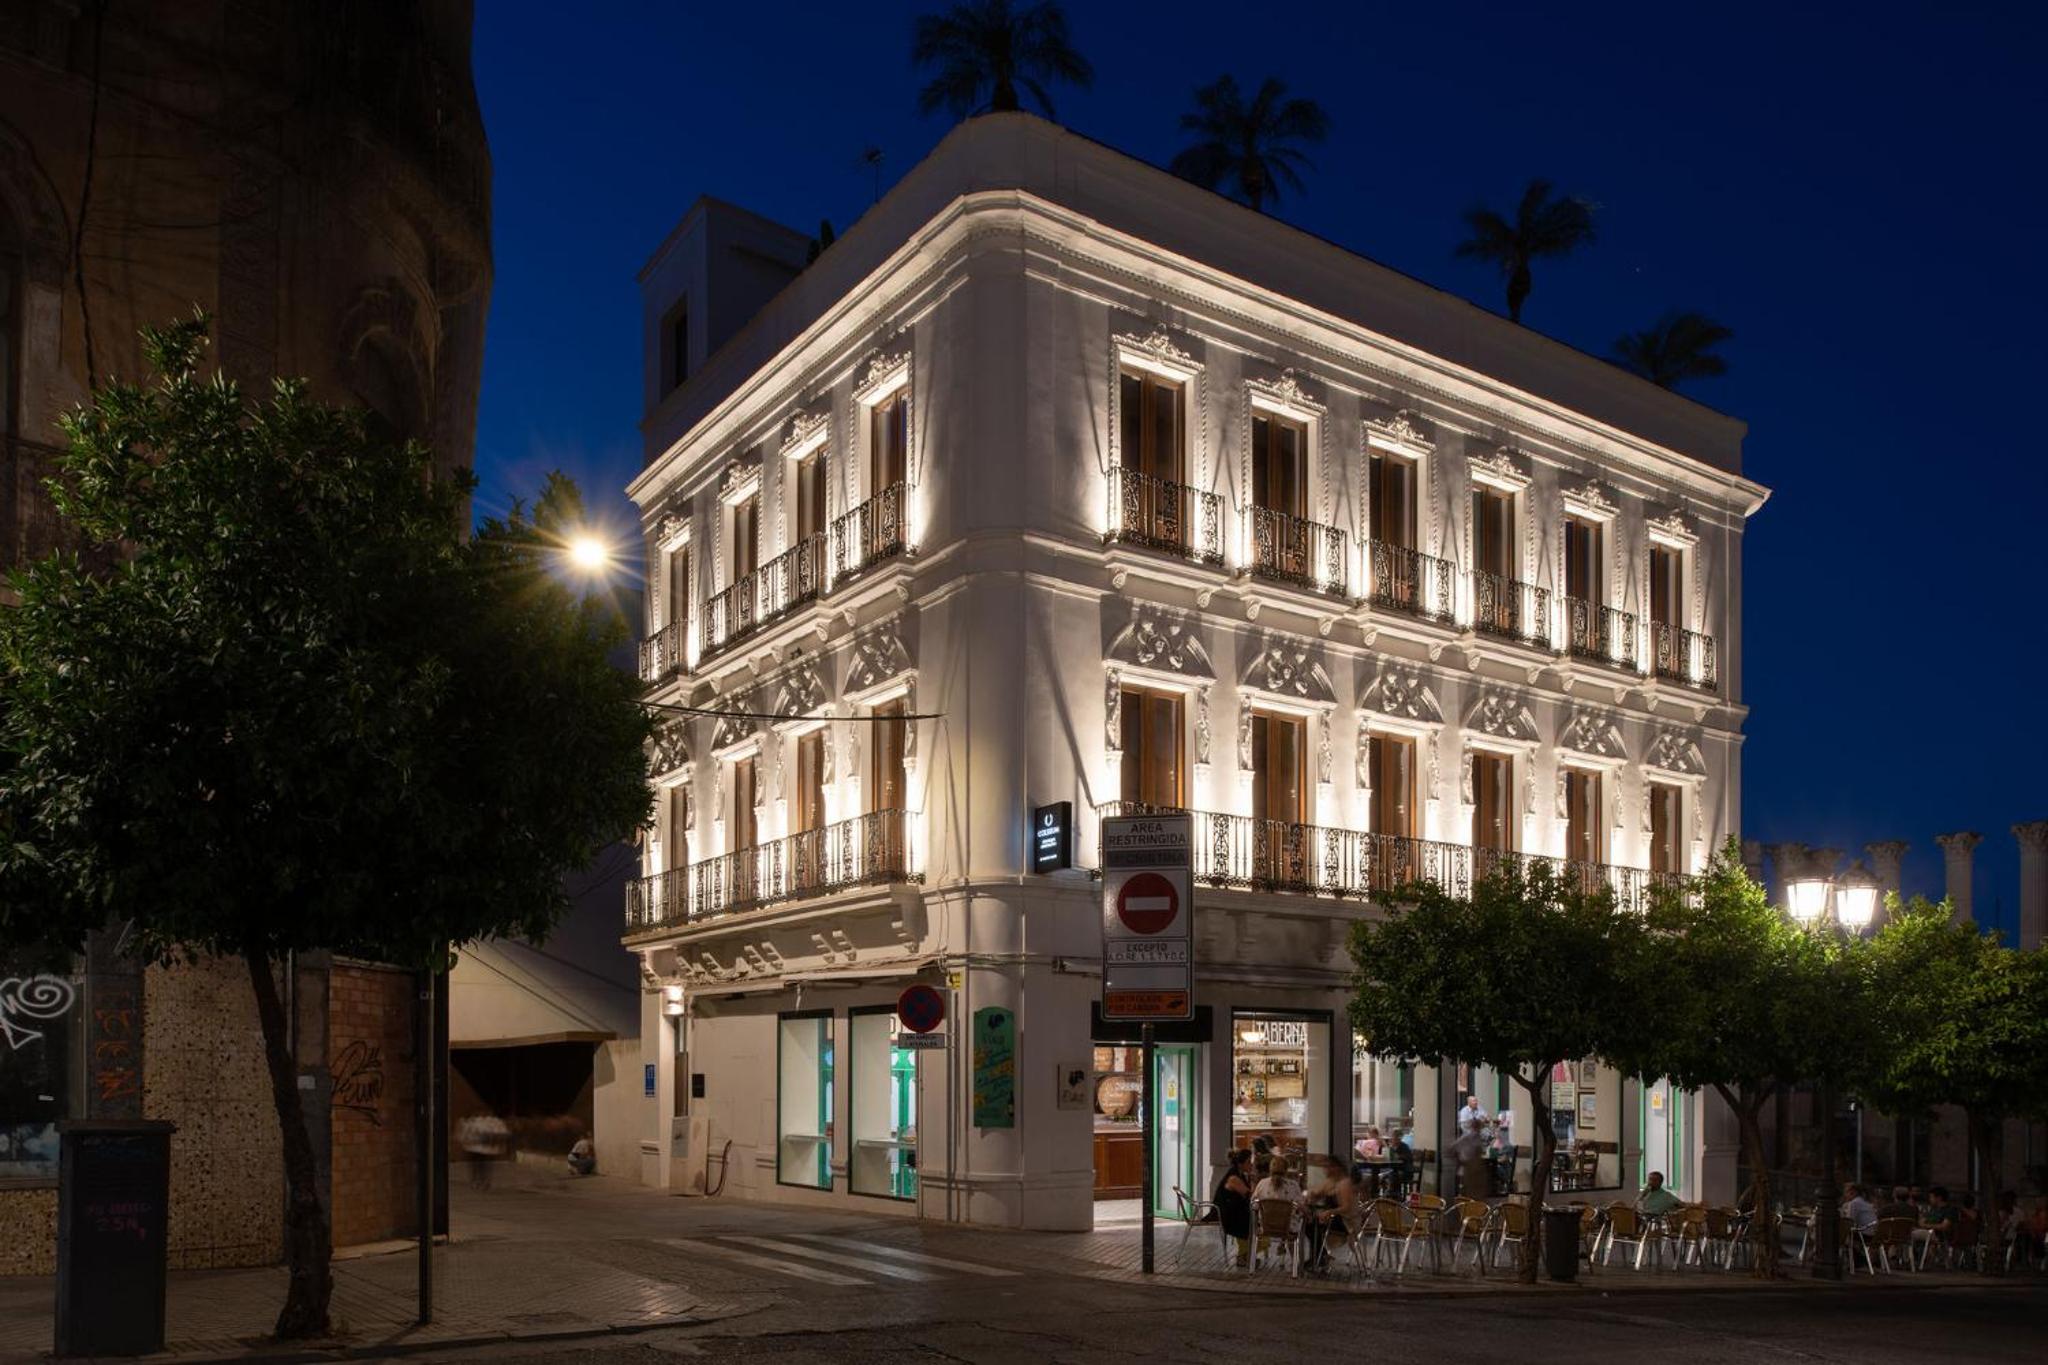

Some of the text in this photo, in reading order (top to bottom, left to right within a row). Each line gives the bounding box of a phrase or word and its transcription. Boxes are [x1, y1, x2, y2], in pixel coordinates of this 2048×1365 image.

[1130, 822, 1163, 834] AREA
[1109, 833, 1186, 845] RESTRINGIDA
[1256, 1021, 1308, 1045] TABERNA
